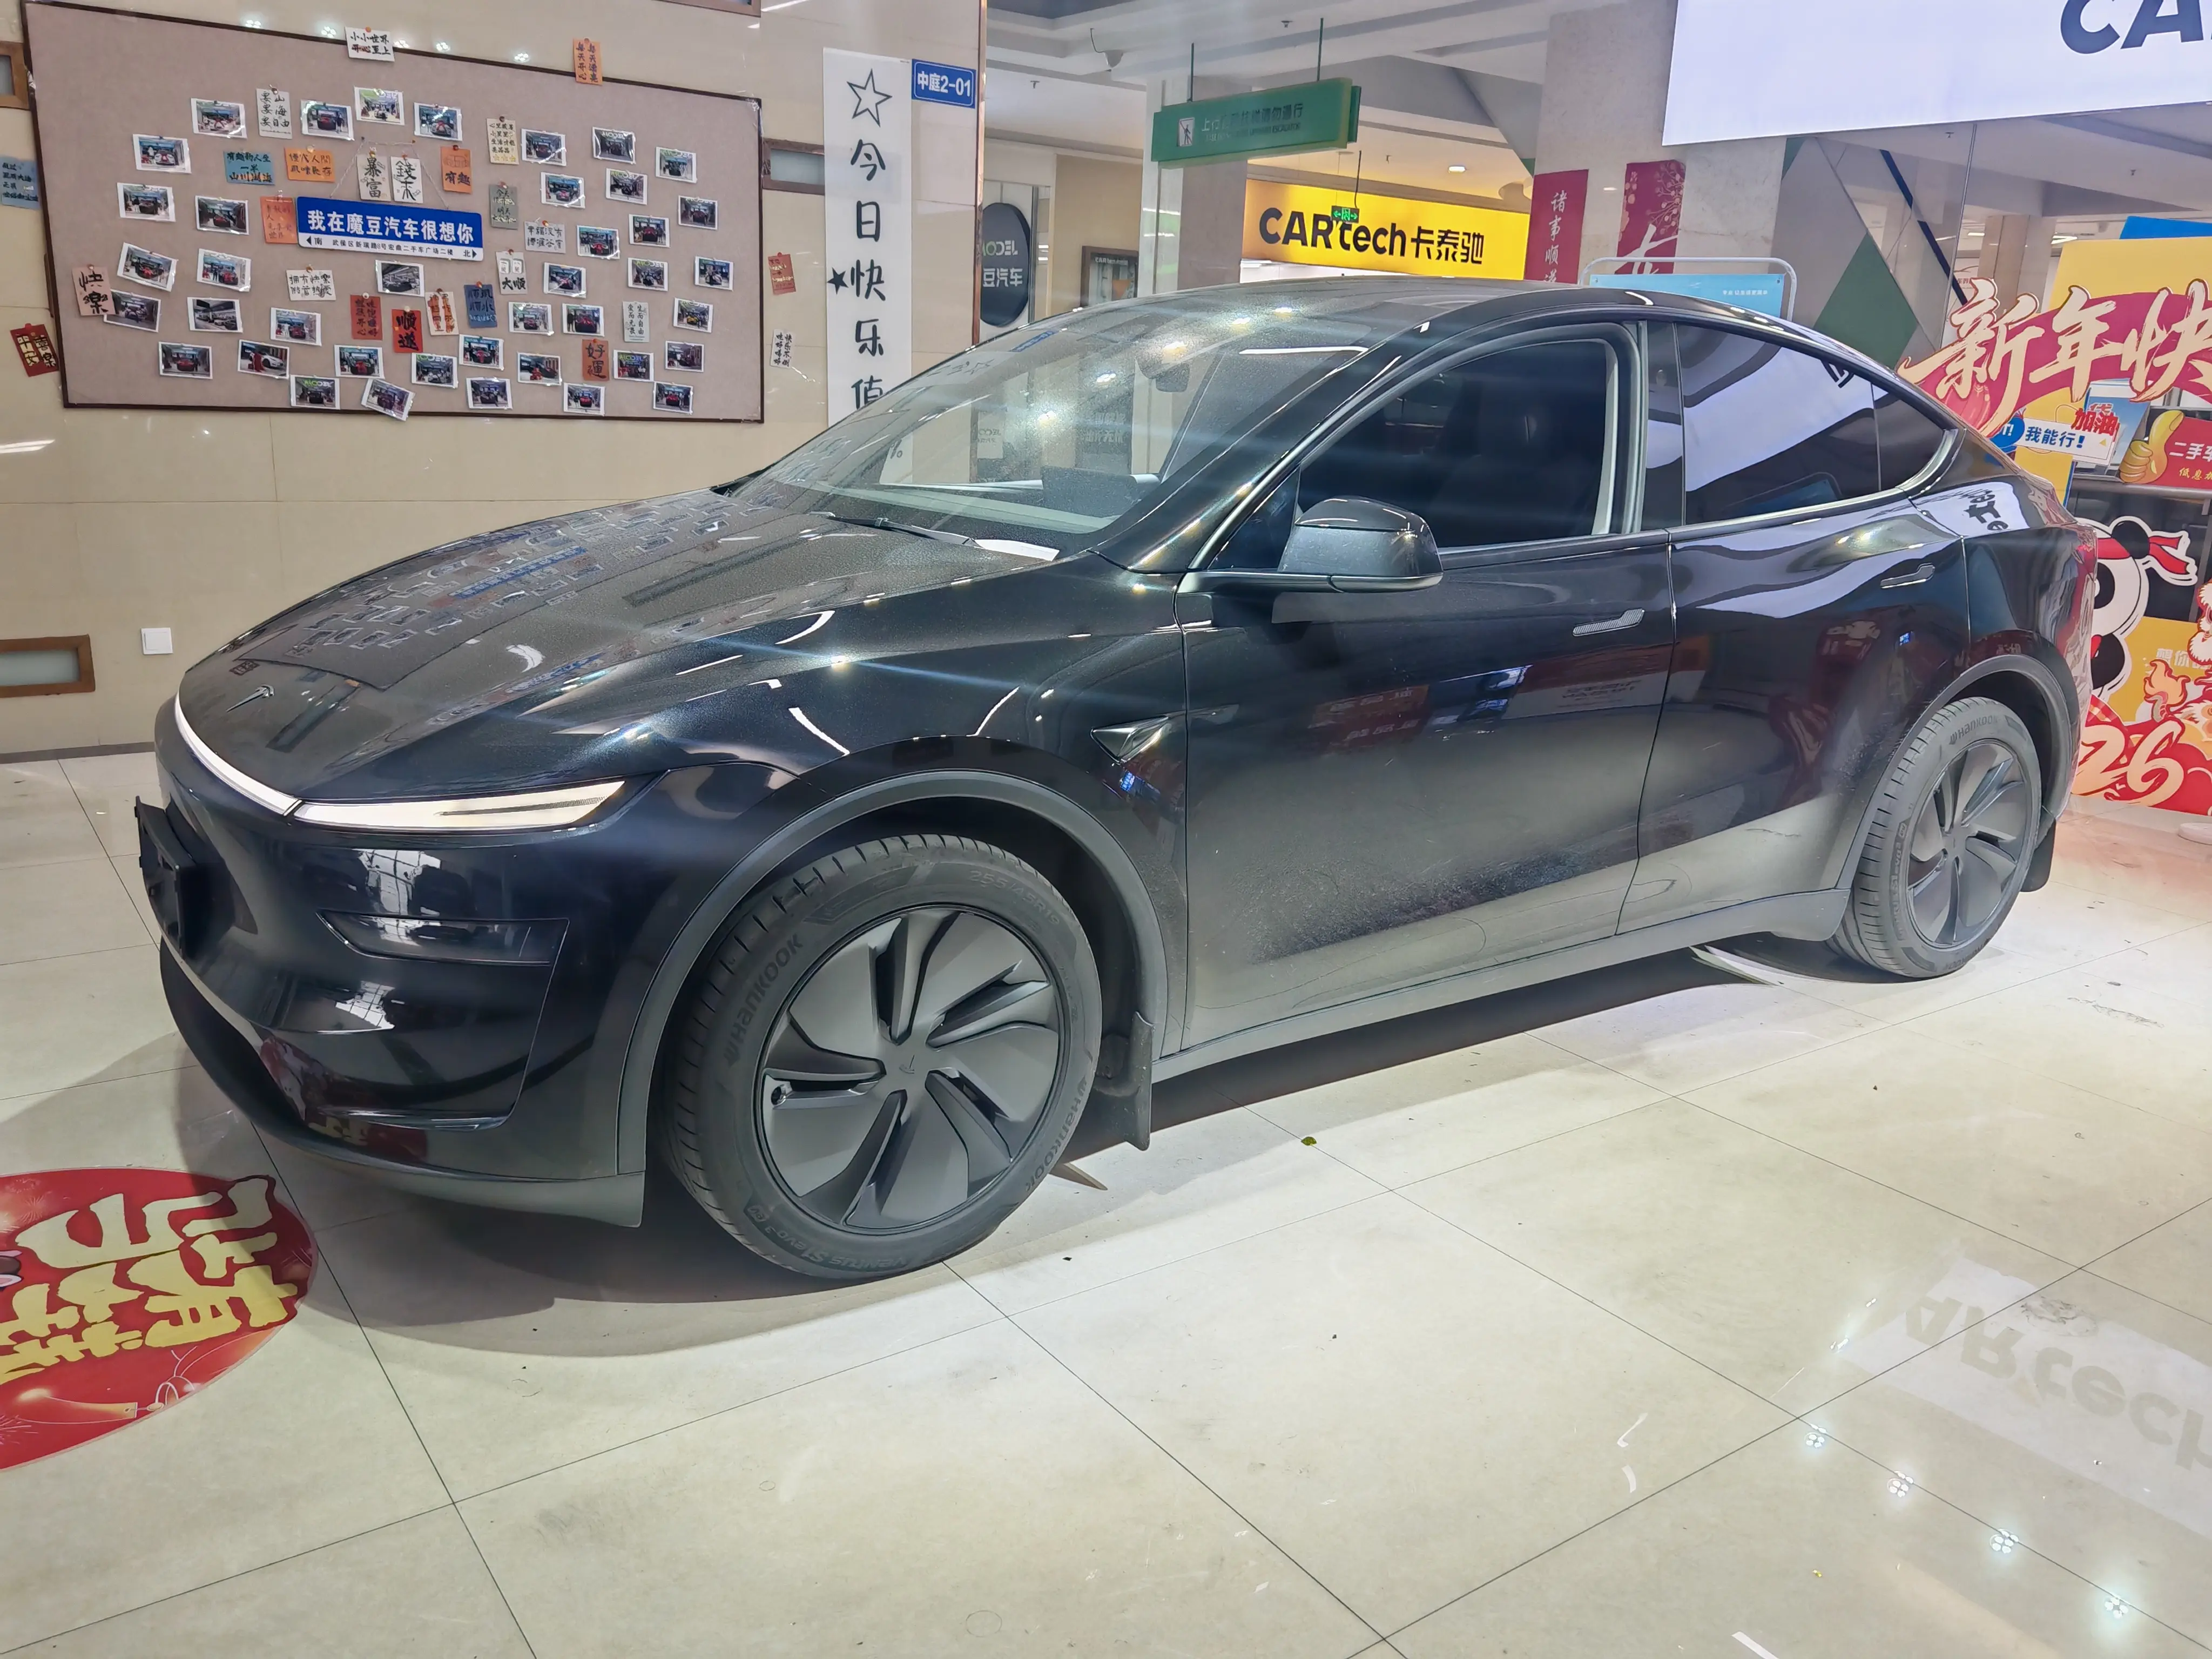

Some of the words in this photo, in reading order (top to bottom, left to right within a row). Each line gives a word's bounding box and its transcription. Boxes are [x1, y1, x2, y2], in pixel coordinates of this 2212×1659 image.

[350, 31, 389, 44] 小小世界
[917, 70, 971, 97] 中庭2-01
[365, 157, 382, 198] 暴富
[445, 171, 471, 186] 有趣
[307, 210, 474, 244] 我在魔豆汽车很想你
[1259, 207, 1407, 257] CARtech
[463, 249, 471, 258] 北
[1411, 226, 1484, 264] 卡泰驰
[983, 268, 1023, 287] 豆汽车
[1897, 278, 2212, 436] 新年快
[2025, 426, 2085, 449] 我能行!
